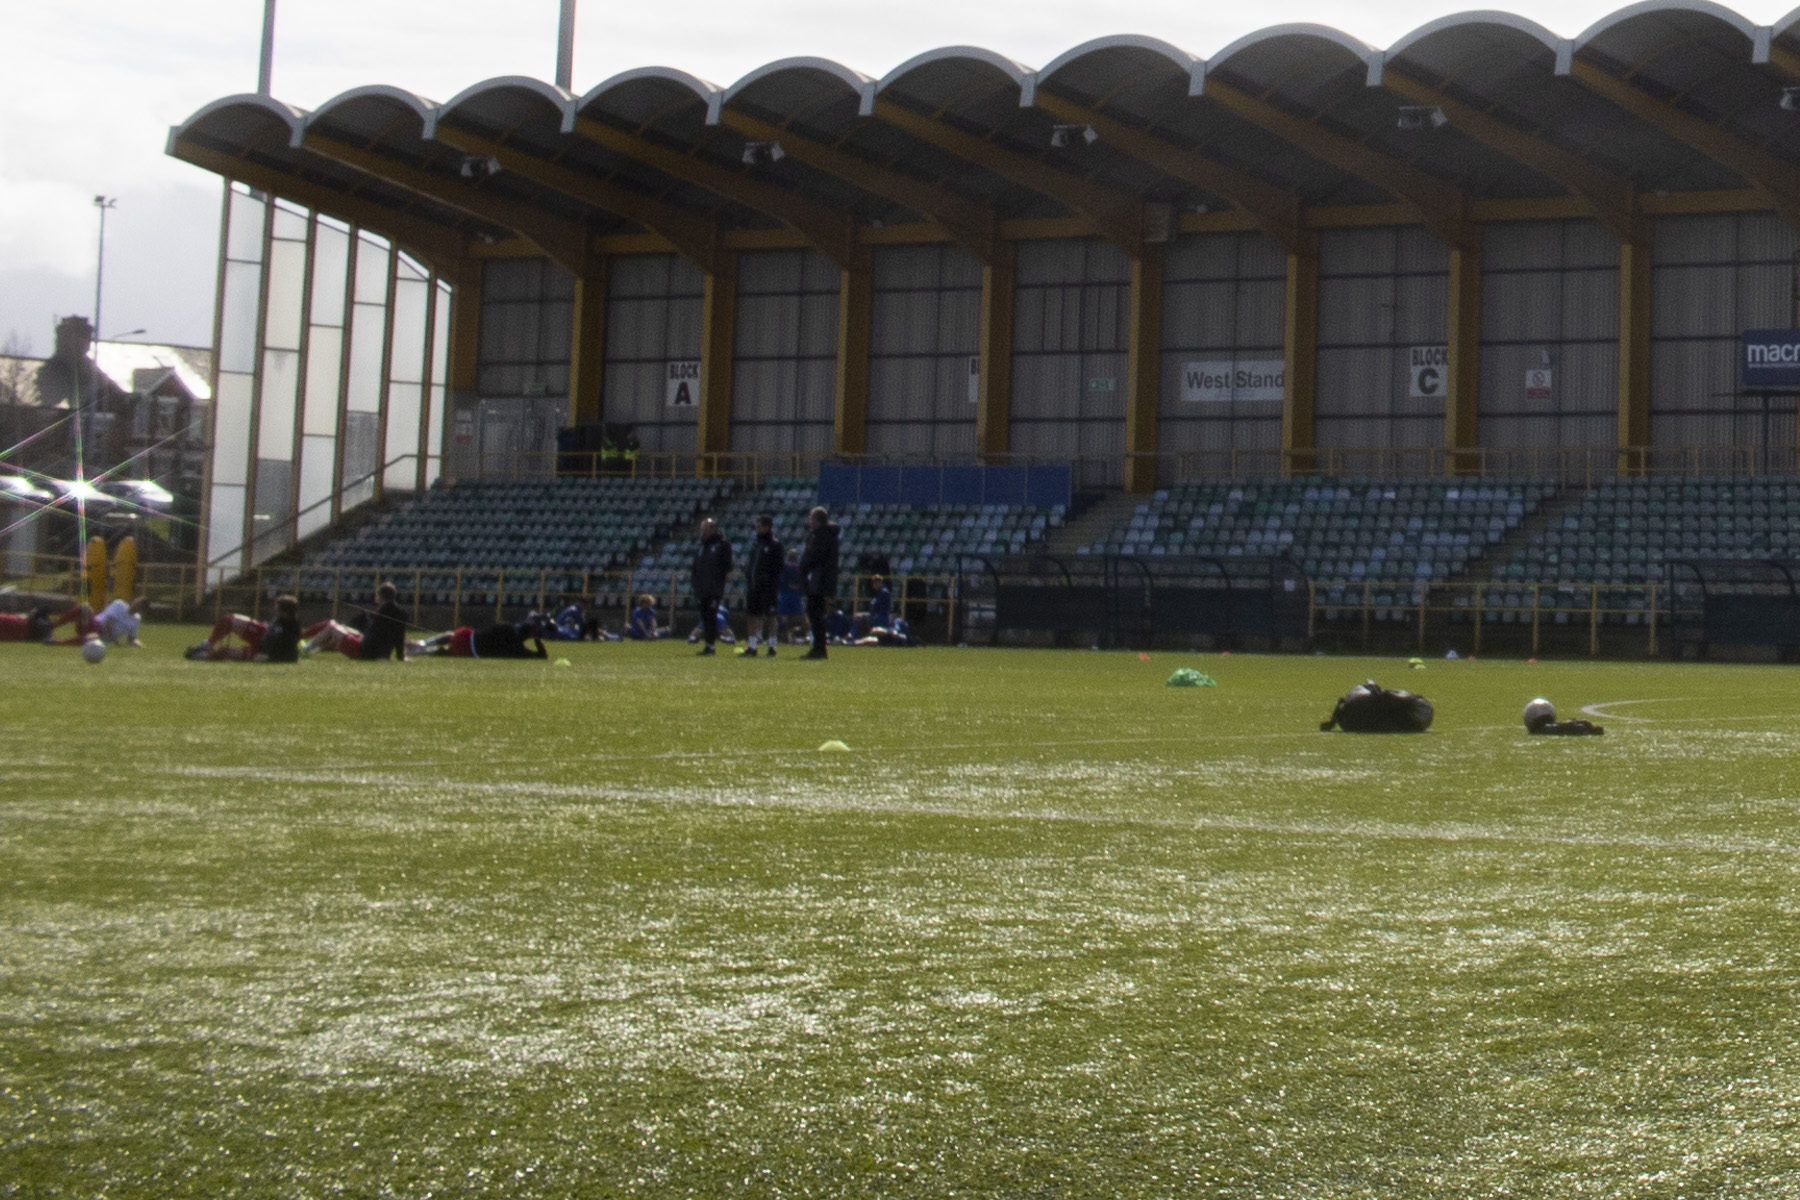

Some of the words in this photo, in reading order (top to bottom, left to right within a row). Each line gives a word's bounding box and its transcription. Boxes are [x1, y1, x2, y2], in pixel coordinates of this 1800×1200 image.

[1412, 348, 1449, 366] BLOCK
[670, 363, 699, 379] BLOCK
[1187, 371, 1230, 389] West
[1235, 370, 1285, 389] Stand
[1418, 367, 1440, 395] C
[674, 382, 691, 405] A
